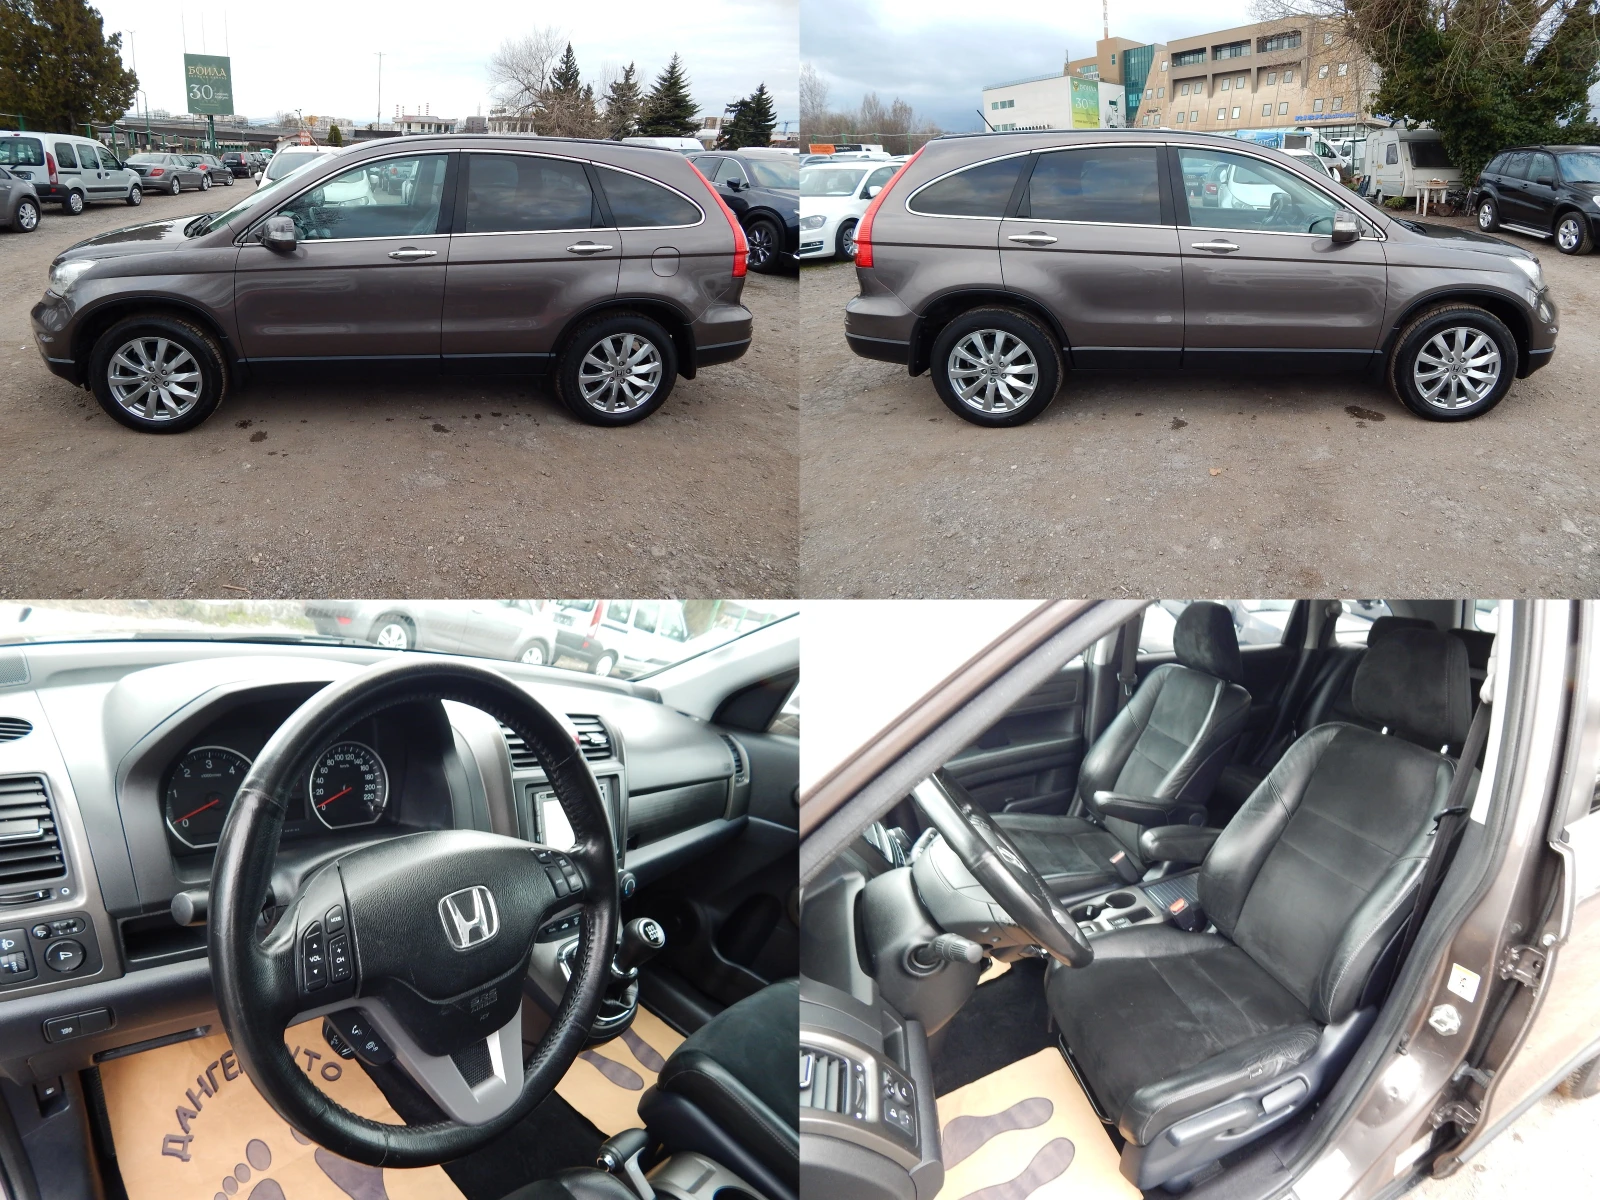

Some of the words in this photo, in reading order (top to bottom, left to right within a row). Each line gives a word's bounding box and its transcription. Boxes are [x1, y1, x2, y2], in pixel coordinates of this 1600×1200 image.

[190, 84, 212, 100] 30
[1075, 97, 1089, 109] 30
[345, 753, 355, 761] 120
[205, 759, 213, 769] 3
[183, 768, 191, 778] 2
[228, 766, 236, 775] 4
[320, 766, 329, 774] 60
[172, 789, 178, 798] 1
[315, 788, 324, 796] 20
[363, 793, 375, 801] 220
[182, 818, 189, 828] 0
[309, 954, 322, 963] VOL
[336, 956, 345, 964] CH
